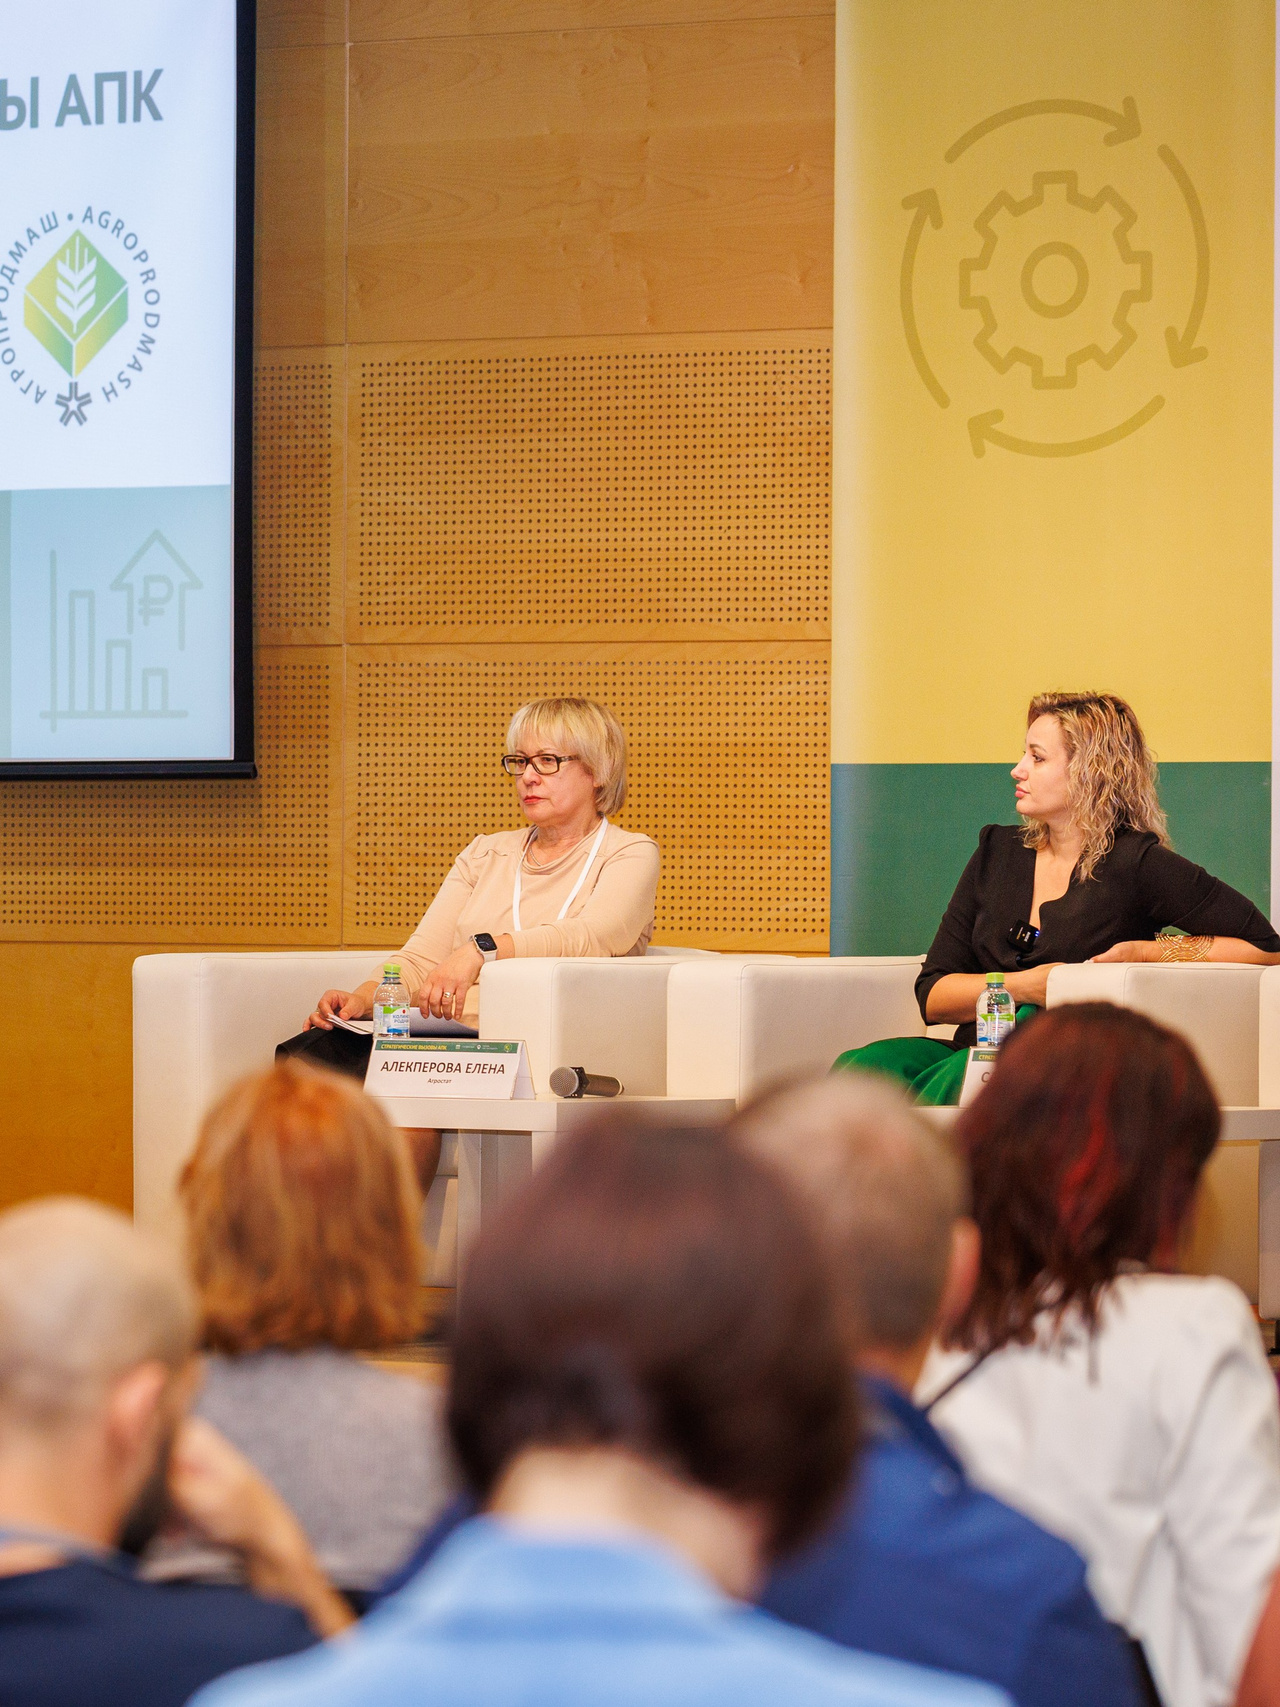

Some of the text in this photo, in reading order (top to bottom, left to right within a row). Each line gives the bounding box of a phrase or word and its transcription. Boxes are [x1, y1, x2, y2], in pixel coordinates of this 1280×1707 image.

[54, 68, 164, 128] АПК
[82, 206, 161, 402] AGROPRODMASH
[380, 1061, 505, 1075] АЛЕКПЕРОВА ЕЛЕНА
